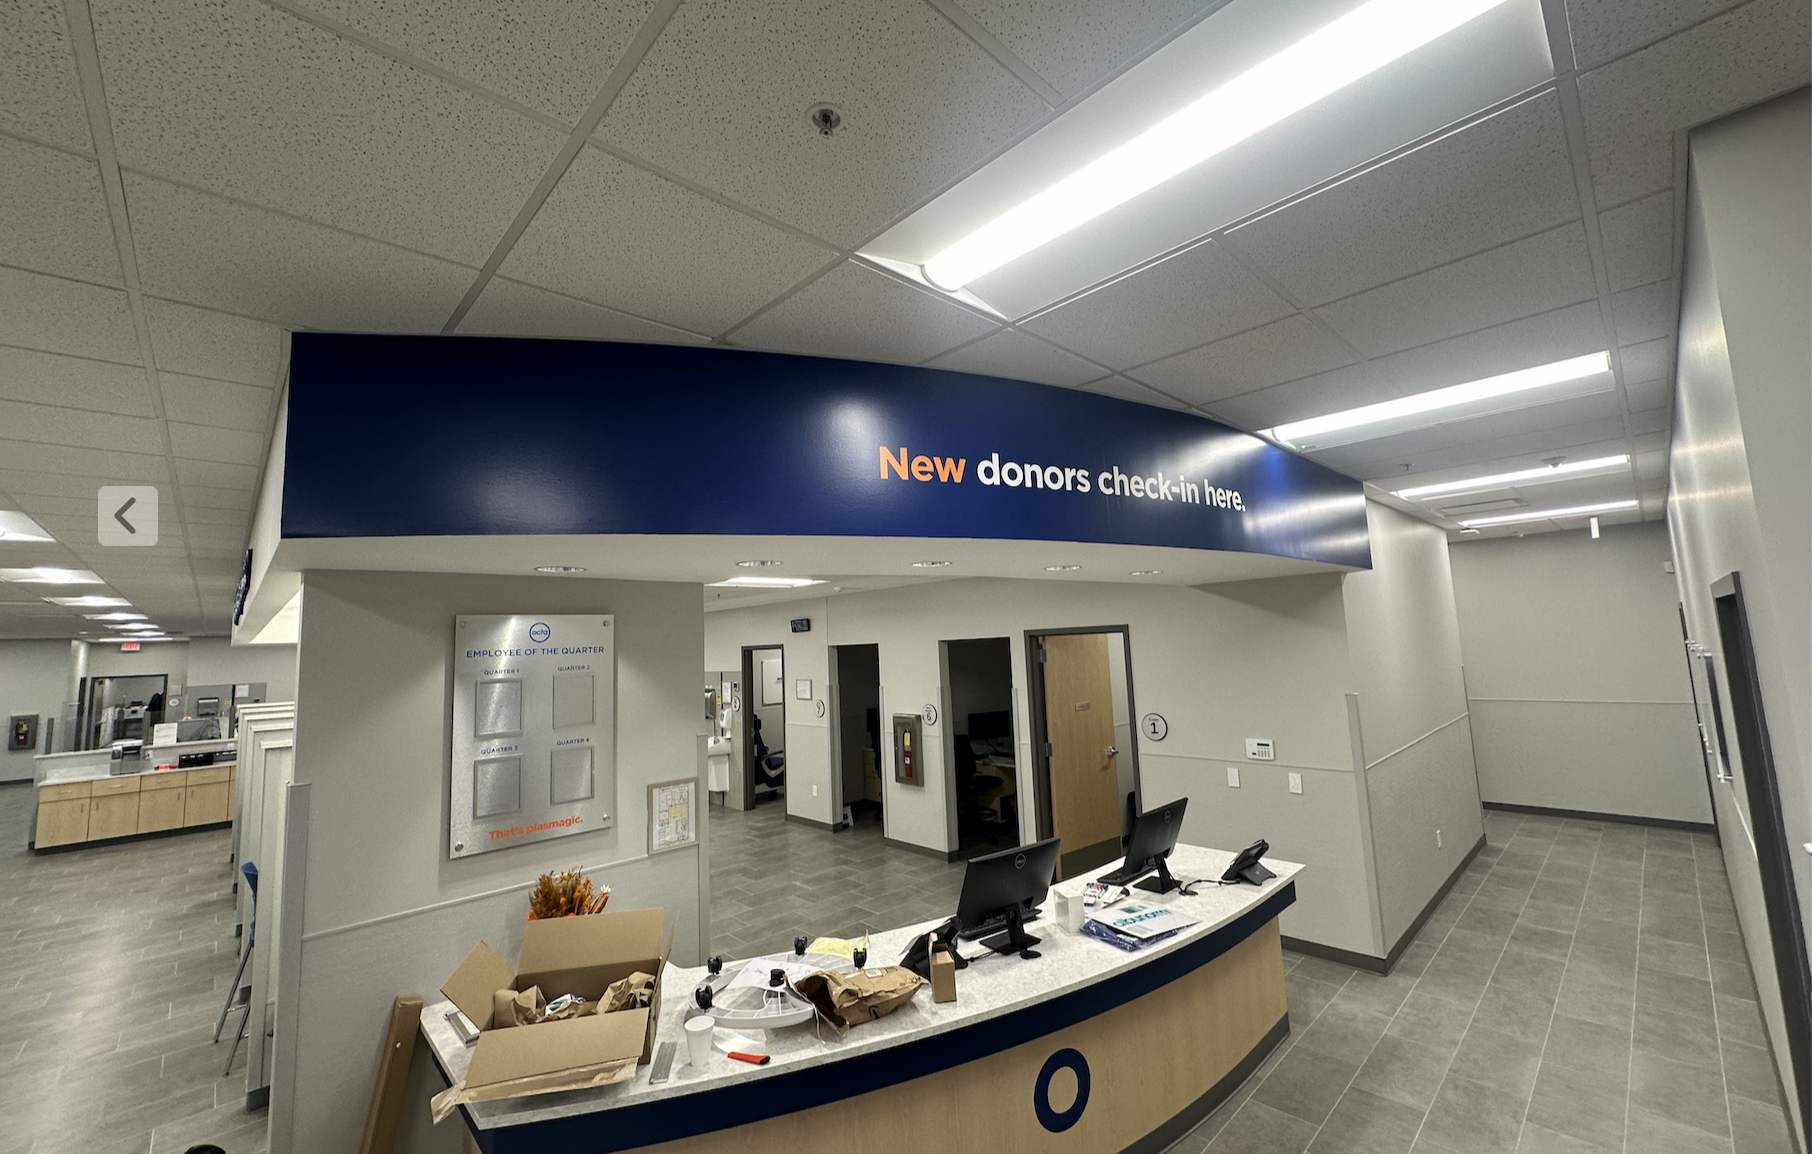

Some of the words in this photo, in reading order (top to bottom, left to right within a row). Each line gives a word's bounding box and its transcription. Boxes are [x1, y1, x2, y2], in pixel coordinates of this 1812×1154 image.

[879, 446, 966, 483] New
[977, 453, 1091, 493] donors
[1098, 466, 1200, 504] check-in
[1203, 479, 1246, 511] here.
[466, 649, 522, 658] EMPLOYEE
[524, 648, 538, 656] OF
[540, 647, 559, 655] THE
[561, 646, 605, 655] QUARTER
[926, 712, 932, 721] 6
[1150, 722, 1159, 734] 1
[556, 738, 585, 746] QUARTER
[480, 746, 514, 754] QUARTER
[489, 826, 524, 839] That's
[526, 816, 583, 834] plasmagic.
